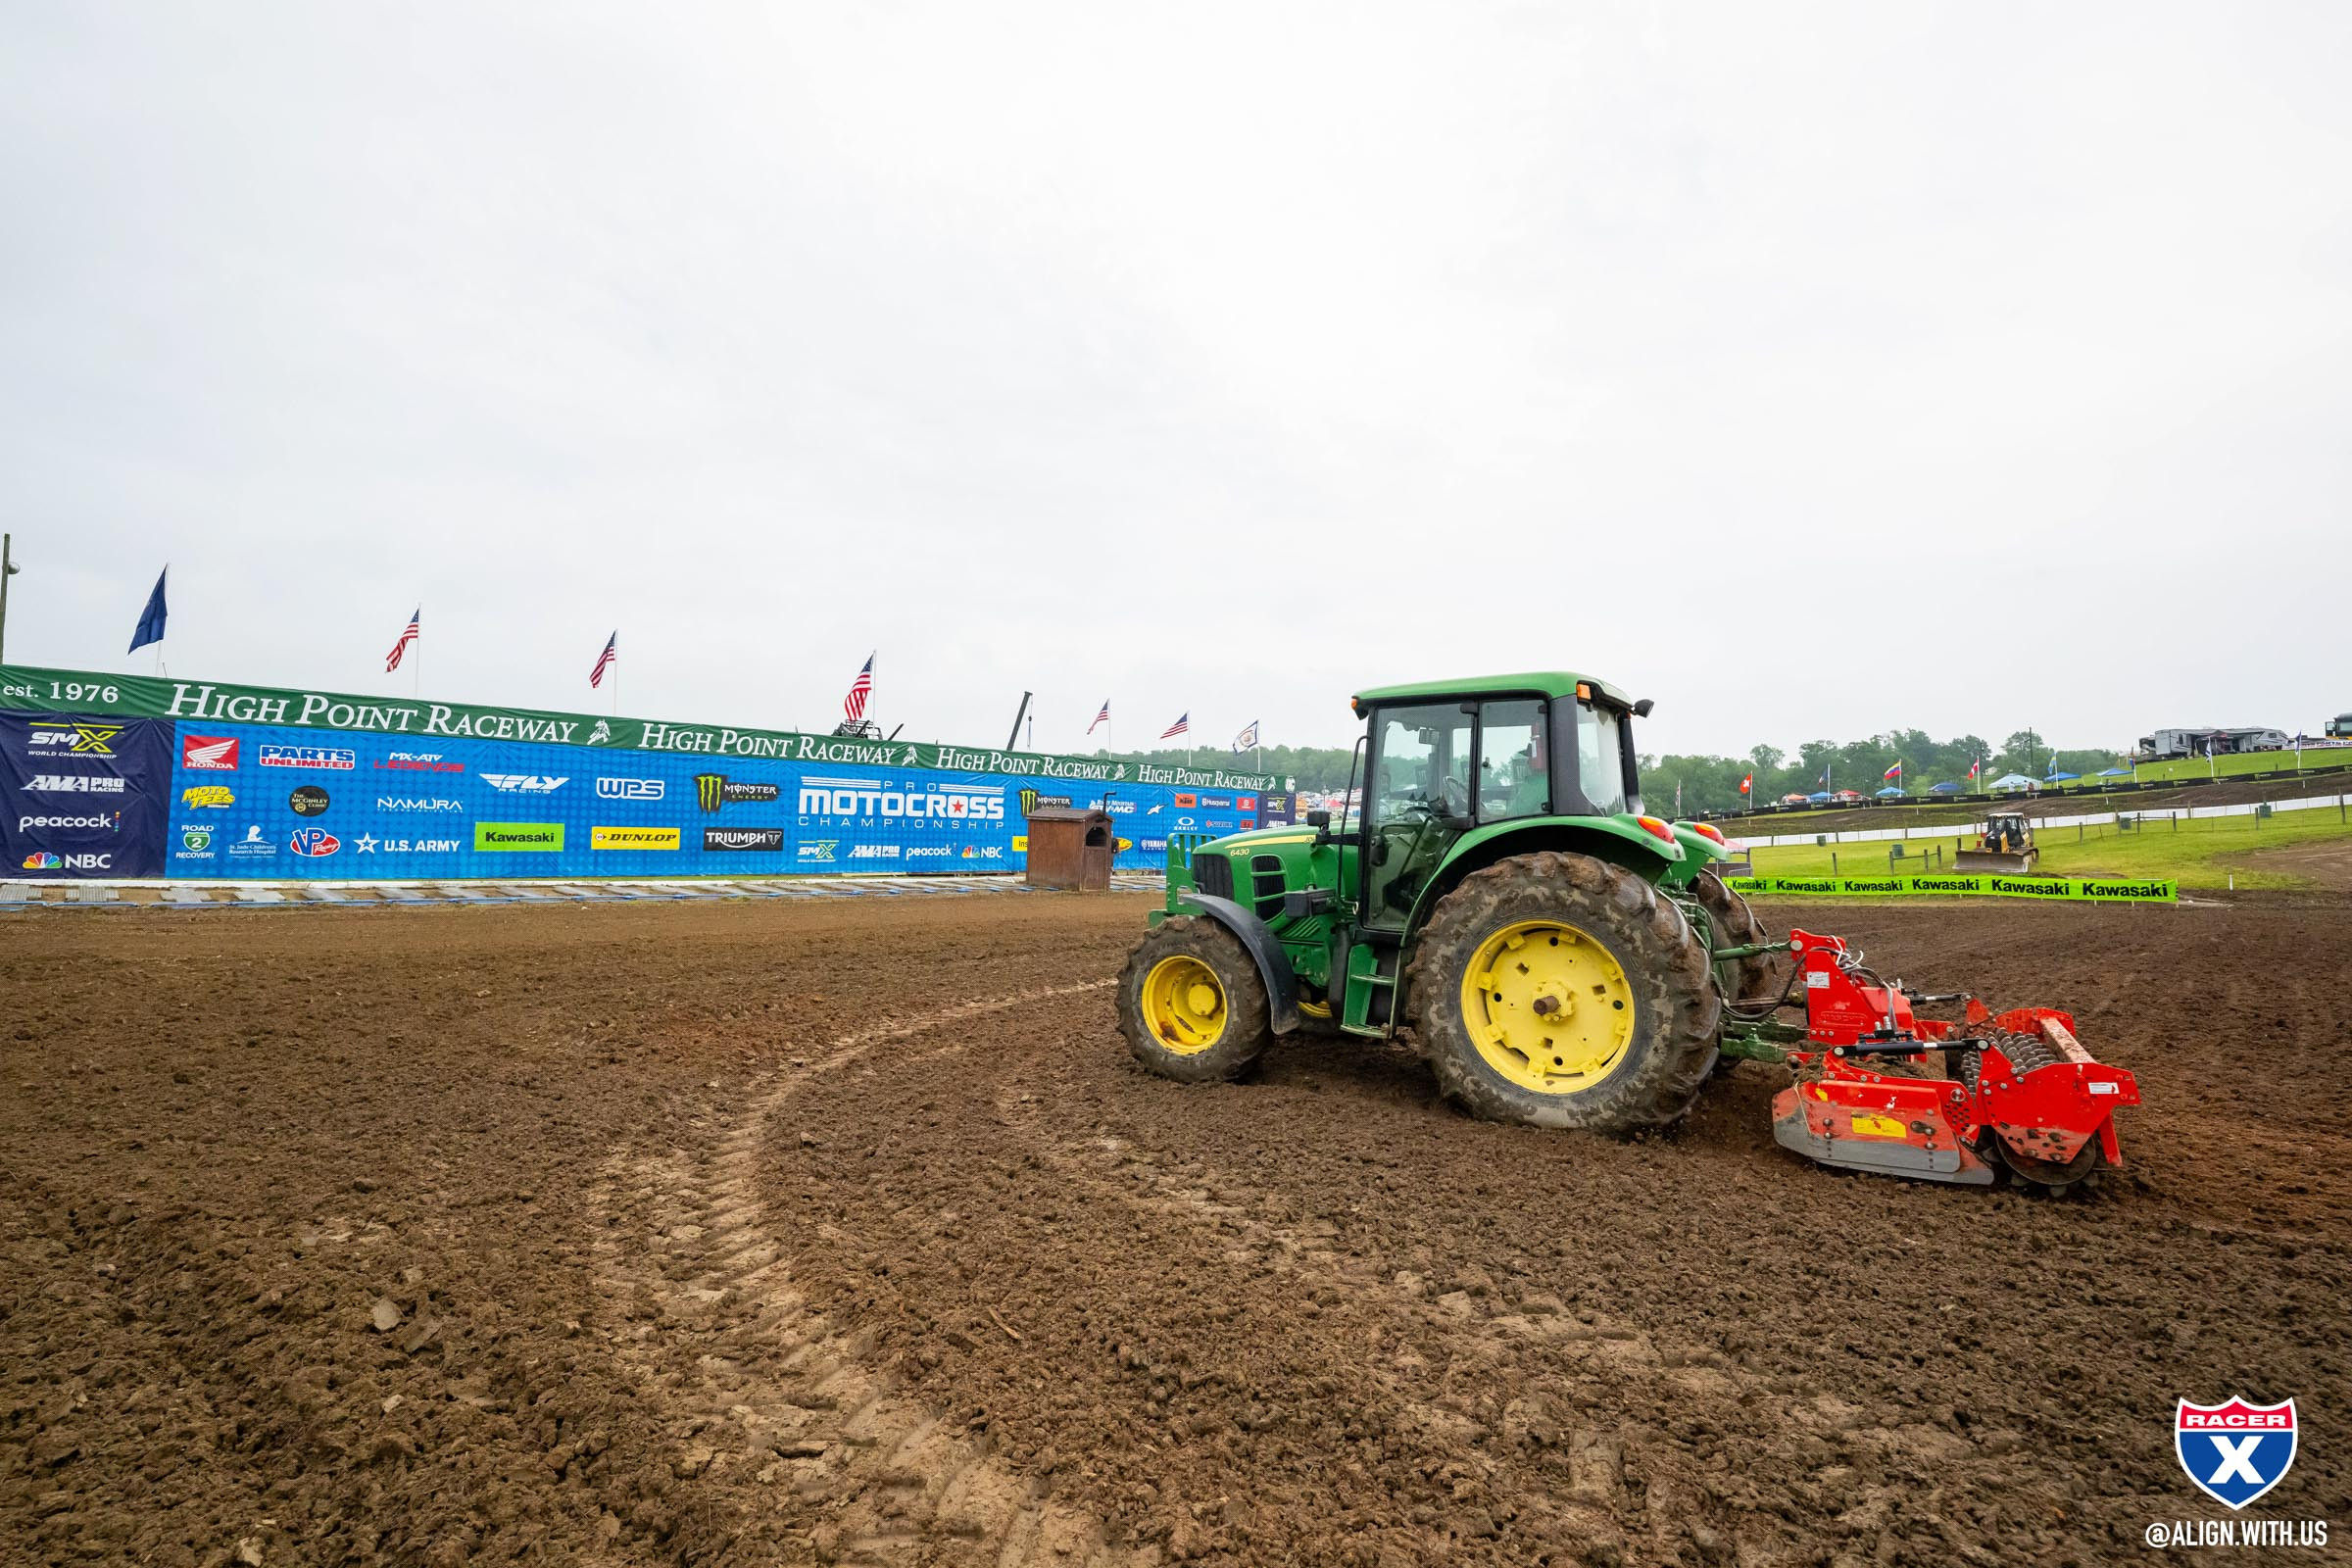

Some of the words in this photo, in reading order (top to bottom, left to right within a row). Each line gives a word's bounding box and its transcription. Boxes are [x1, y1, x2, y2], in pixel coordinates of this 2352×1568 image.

[3, 684, 39, 698] est.
[49, 681, 119, 704] 1976
[165, 683, 290, 723] HIGH
[294, 694, 417, 731] POINT
[423, 705, 578, 742] RACEWAY
[27, 728, 118, 753] SMX
[638, 722, 713, 752] HIGH
[716, 729, 793, 759] POINT
[796, 736, 897, 764] RACEWAY
[261, 746, 354, 760] PARTS
[389, 752, 443, 761] MX-ATV
[261, 759, 354, 769] UNLIMITED
[935, 747, 985, 771] HIGH
[987, 752, 1040, 775] POINT
[1042, 757, 1110, 779] RACEWAY
[20, 774, 89, 792] AMA
[90, 776, 124, 788] PRO
[494, 774, 570, 790] FLY
[1137, 764, 1173, 784] HIGH
[1174, 767, 1212, 786] POINT
[1214, 770, 1266, 790] RACEWAY
[596, 777, 665, 800] WPS
[724, 784, 777, 795] MONSTER
[884, 780, 937, 792] PRO
[181, 786, 230, 803] MOTO
[1037, 797, 1071, 806] MONSTER
[189, 795, 236, 810] TEES
[377, 796, 463, 810] NAMURA
[798, 788, 1004, 820] MOTOCROSS
[20, 812, 112, 833] peacock
[798, 816, 1004, 829] CHAMPIONSHIP
[191, 837, 202, 849] 2
[292, 828, 327, 857] VP
[485, 832, 555, 843] Kawasaki
[609, 833, 677, 842] DUNLOP
[707, 833, 766, 846] TRIUMPH
[384, 840, 412, 852] U.S.
[415, 840, 461, 853] ARMY
[798, 844, 837, 858] SMX
[847, 845, 882, 858] AMA
[906, 844, 953, 861] peacock
[981, 846, 1004, 858] NBC
[1230, 848, 1250, 857] 6430
[65, 854, 112, 869] NBC
[1732, 879, 1767, 891] Kawasaki
[1776, 879, 1837, 892] Kawasaki
[1844, 880, 1903, 892] Kawasaki
[1912, 878, 1980, 891] Kawasaki
[1991, 879, 2070, 896] Kawasaki
[2082, 882, 2168, 898] Kawasaki
